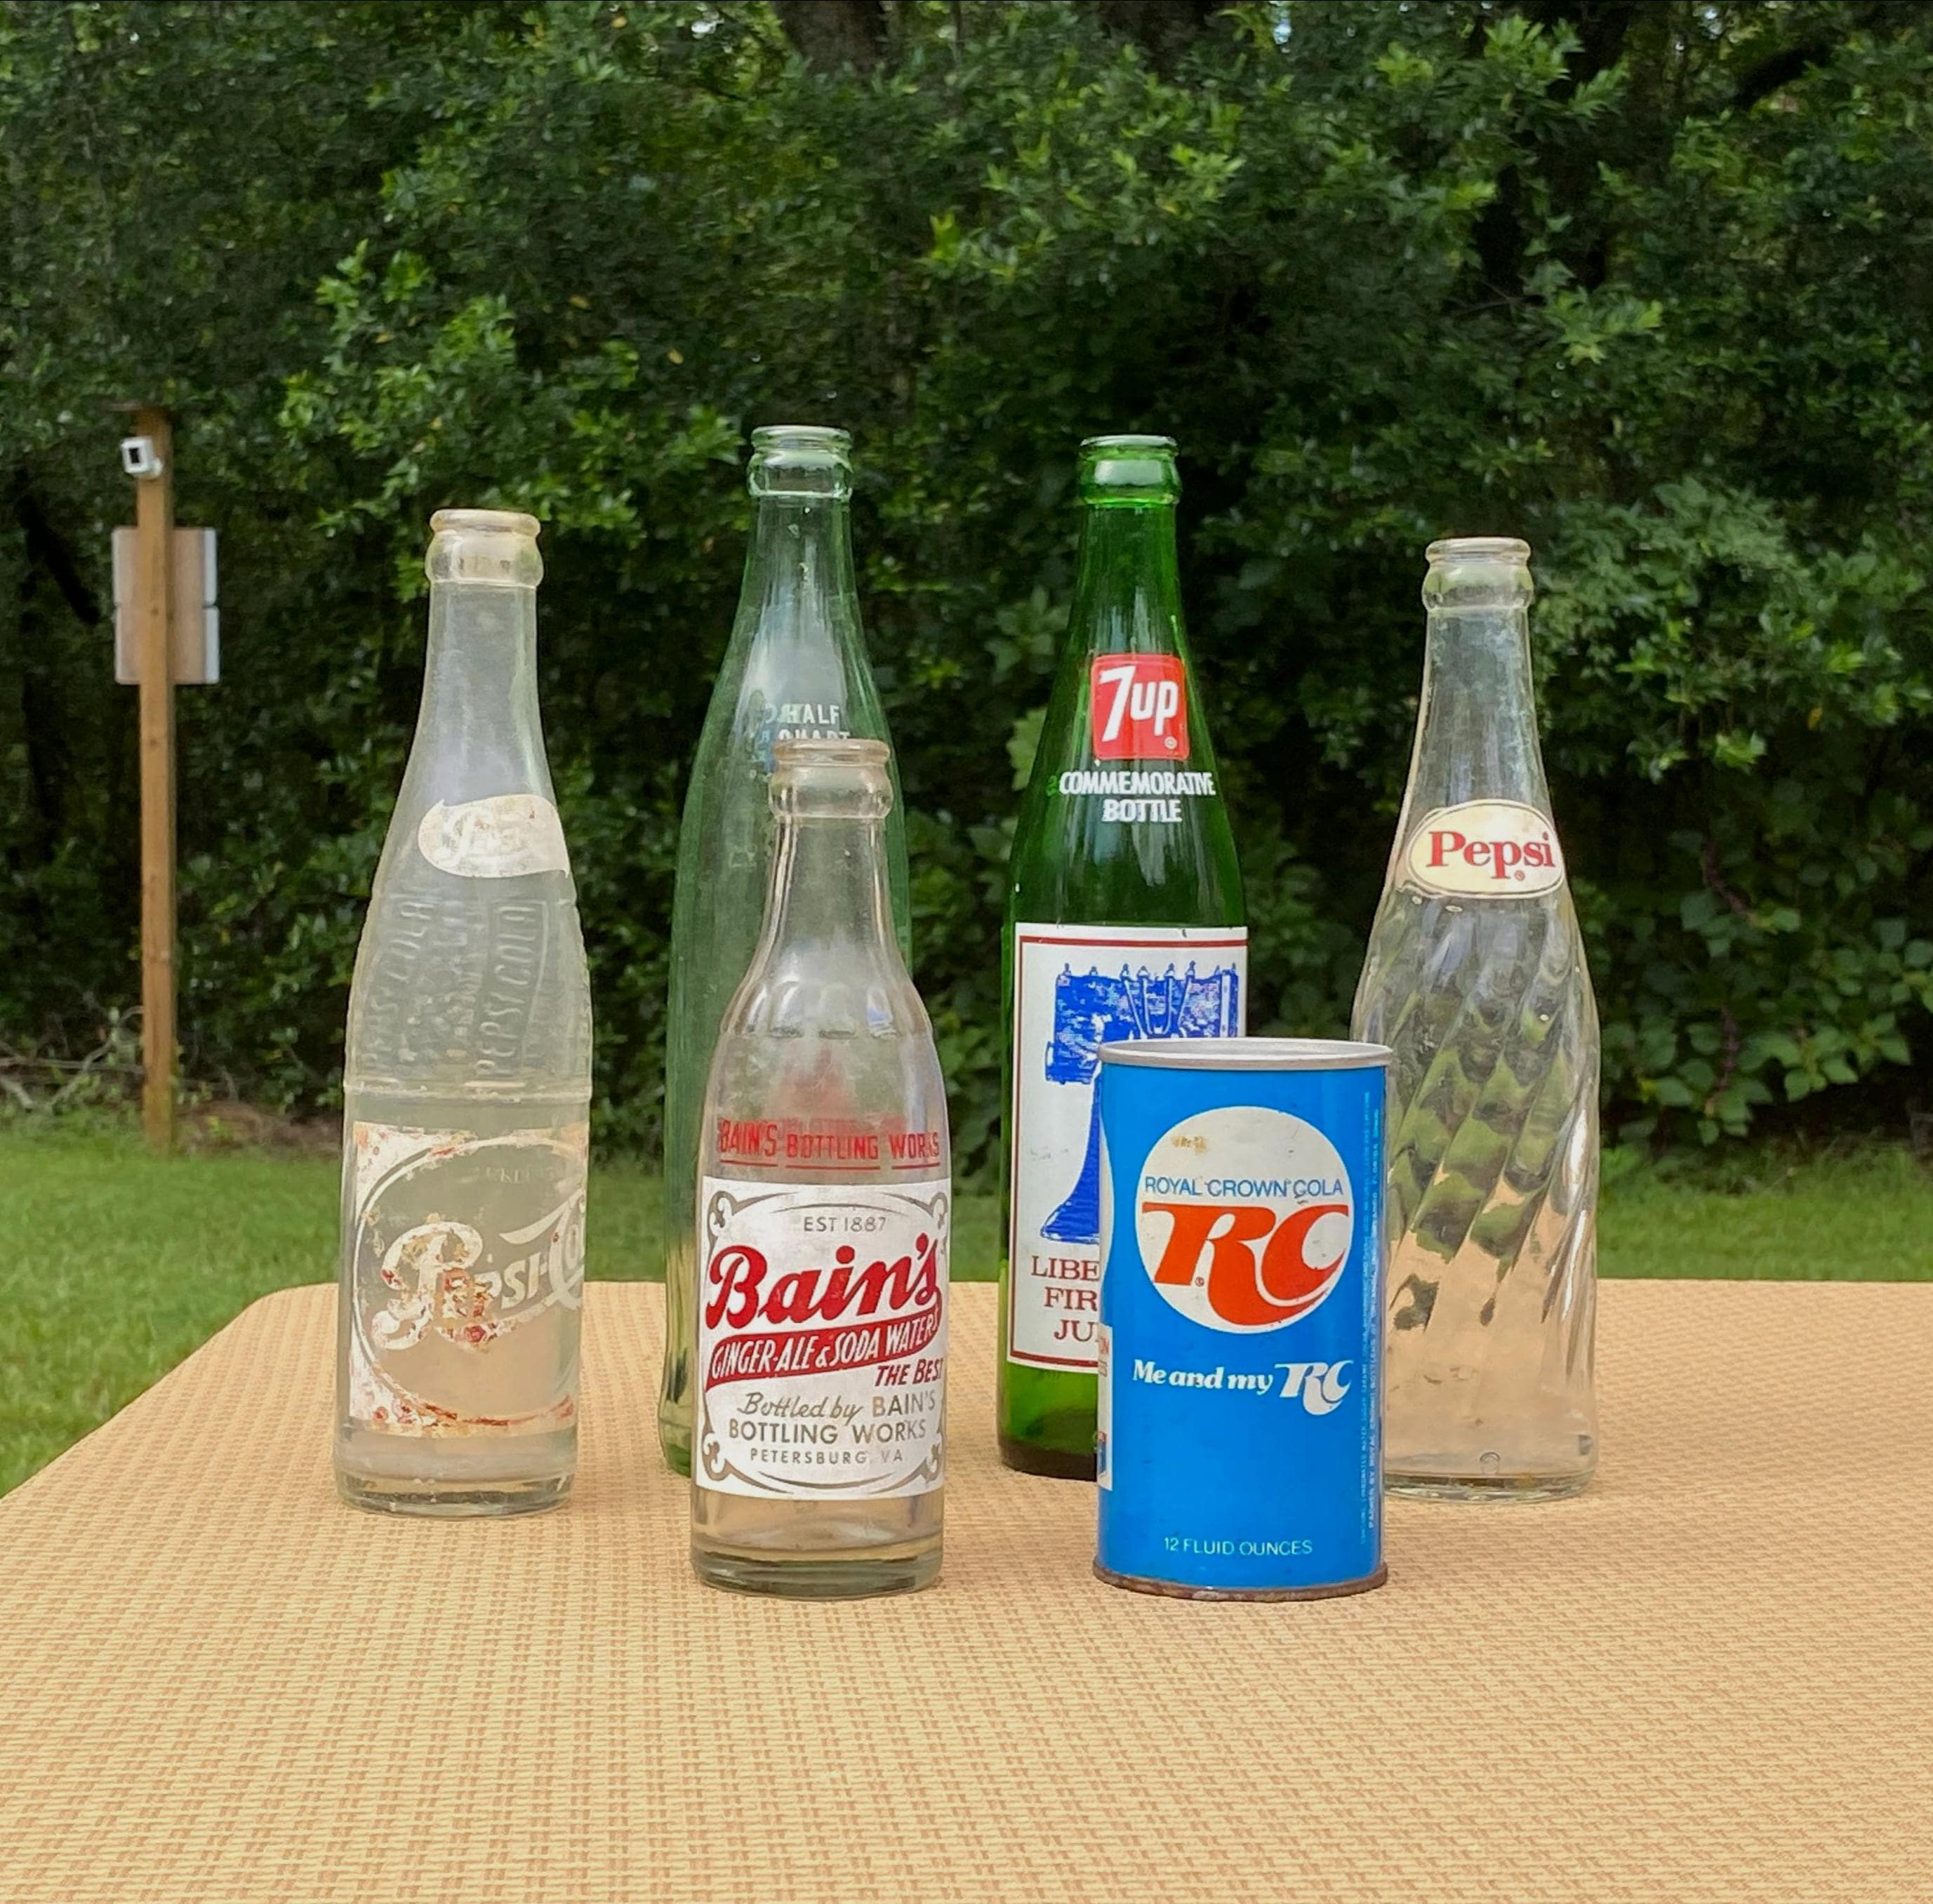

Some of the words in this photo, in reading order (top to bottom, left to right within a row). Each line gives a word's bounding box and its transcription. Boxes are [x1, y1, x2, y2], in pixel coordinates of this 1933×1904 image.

[784, 704, 840, 724] HALF
[1059, 771, 1216, 796] COMMEMORATIVE
[1101, 798, 1183, 823] BOTTLE
[1426, 831, 1555, 879] Pepsi
[719, 1118, 778, 1157] BAIN'S
[785, 1133, 879, 1160] BOTTLING
[1145, 1176, 1202, 1194] ROYAL
[1207, 1179, 1288, 1197] CROWN
[1293, 1178, 1344, 1197] COLA
[804, 1217, 842, 1232] EST
[844, 1216, 886, 1232] 1887
[1031, 1255, 1101, 1281] LIBE
[1141, 1201, 1349, 1326] RC
[705, 1232, 939, 1331] Bain's
[1044, 1286, 1098, 1312] FIR
[829, 1327, 879, 1367] SODA
[885, 1310, 939, 1357] WATERS
[1054, 1319, 1098, 1342] JU
[875, 1364, 911, 1387] THE
[1132, 1359, 1165, 1384] Me
[1168, 1366, 1223, 1390] and
[1227, 1373, 1274, 1396] my
[1274, 1359, 1355, 1416] RC
[737, 1392, 830, 1418] Bottled
[831, 1395, 865, 1427] by
[872, 1389, 936, 1418] BAIN'S
[729, 1418, 839, 1445] BOTTLING
[851, 1419, 926, 1445] WORKS
[881, 1449, 903, 1463] VA
[1164, 1536, 1178, 1552] 12
[1183, 1538, 1235, 1555] FLUID
[1239, 1539, 1313, 1557] OUNCES
